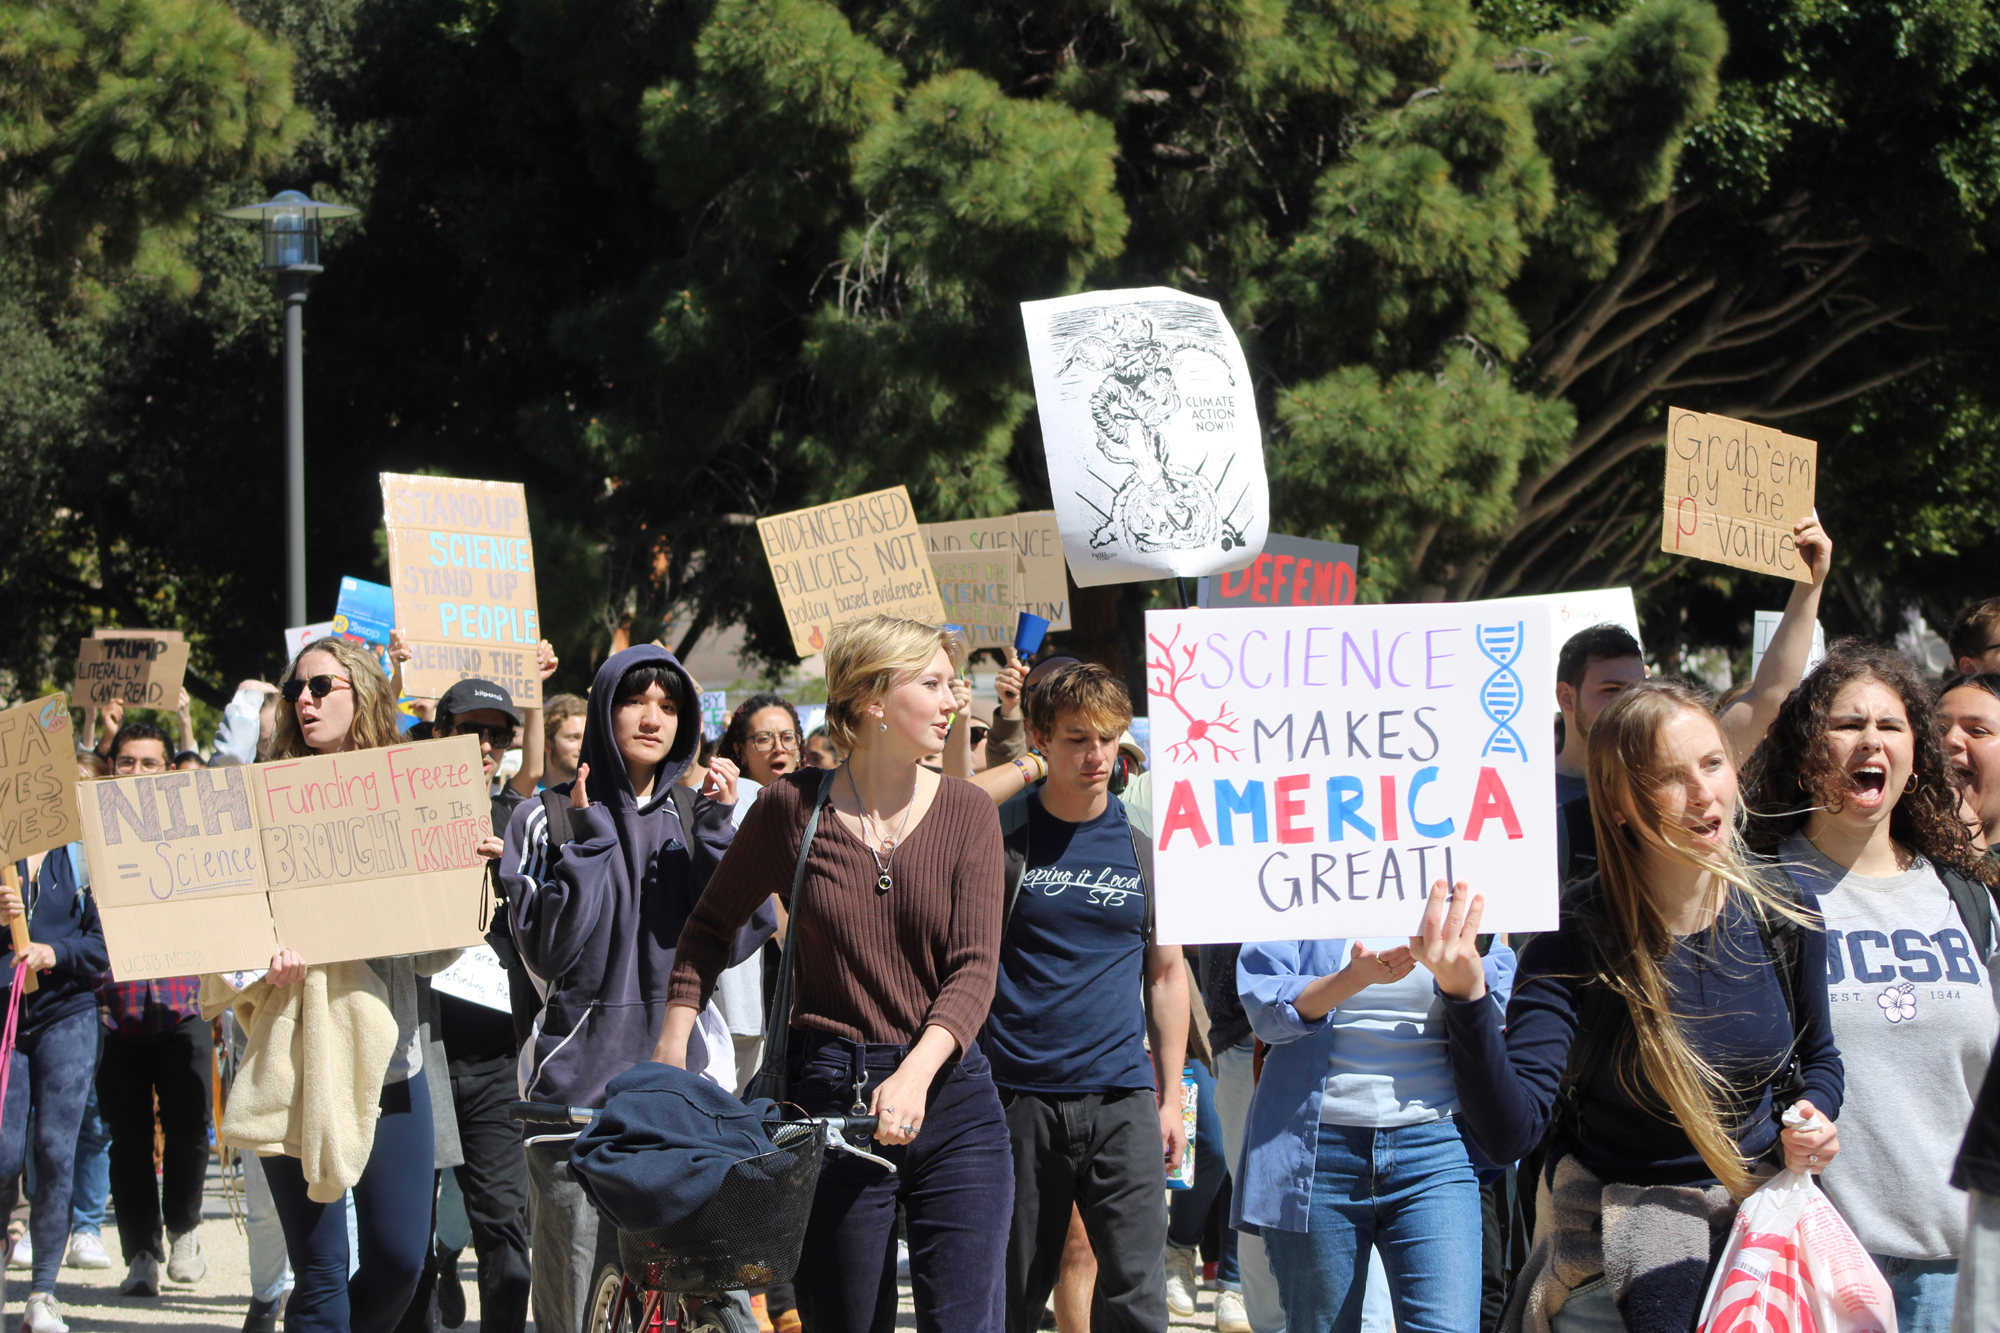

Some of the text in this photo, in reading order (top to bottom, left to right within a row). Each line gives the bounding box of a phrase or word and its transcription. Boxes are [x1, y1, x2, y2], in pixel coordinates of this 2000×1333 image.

[1185, 396, 1236, 408] CLIMATE
[1192, 408, 1236, 420] ACTION
[1196, 420, 1235, 432] NOW!!
[396, 488, 520, 532] STAND UP
[1687, 461, 1785, 521] by the
[761, 492, 909, 557] EVIDENCE BASED
[428, 531, 531, 573] SCIENCE
[773, 531, 918, 599] POLICIES, NOT
[984, 563, 1007, 581] IN
[403, 565, 519, 601] STAND UP
[1219, 552, 1358, 606] DEFEND
[439, 601, 538, 645] PEOPLE
[788, 568, 933, 642] policy based evidence!
[987, 606, 1007, 624] IN
[1560, 604, 1602, 627] Binary
[103, 637, 169, 662] TRUMP
[411, 643, 524, 677] BEHIND THE
[1199, 626, 1465, 691] SCIENCE
[78, 662, 142, 680] LITERALLY
[1252, 706, 1440, 765] MAKES
[96, 766, 253, 846] NIH
[262, 747, 473, 823] Funding Freeze
[1157, 765, 1525, 852] AMERICA
[260, 800, 473, 888] BROUGHT To Its
[149, 842, 257, 900] Science
[1075, 867, 1093, 885] it
[1257, 844, 1456, 914] GREAT!
[1086, 889, 1128, 907] SB
[120, 953, 162, 974] UCSB
[474, 952, 496, 967] are
[1830, 992, 1864, 1003] EST.
